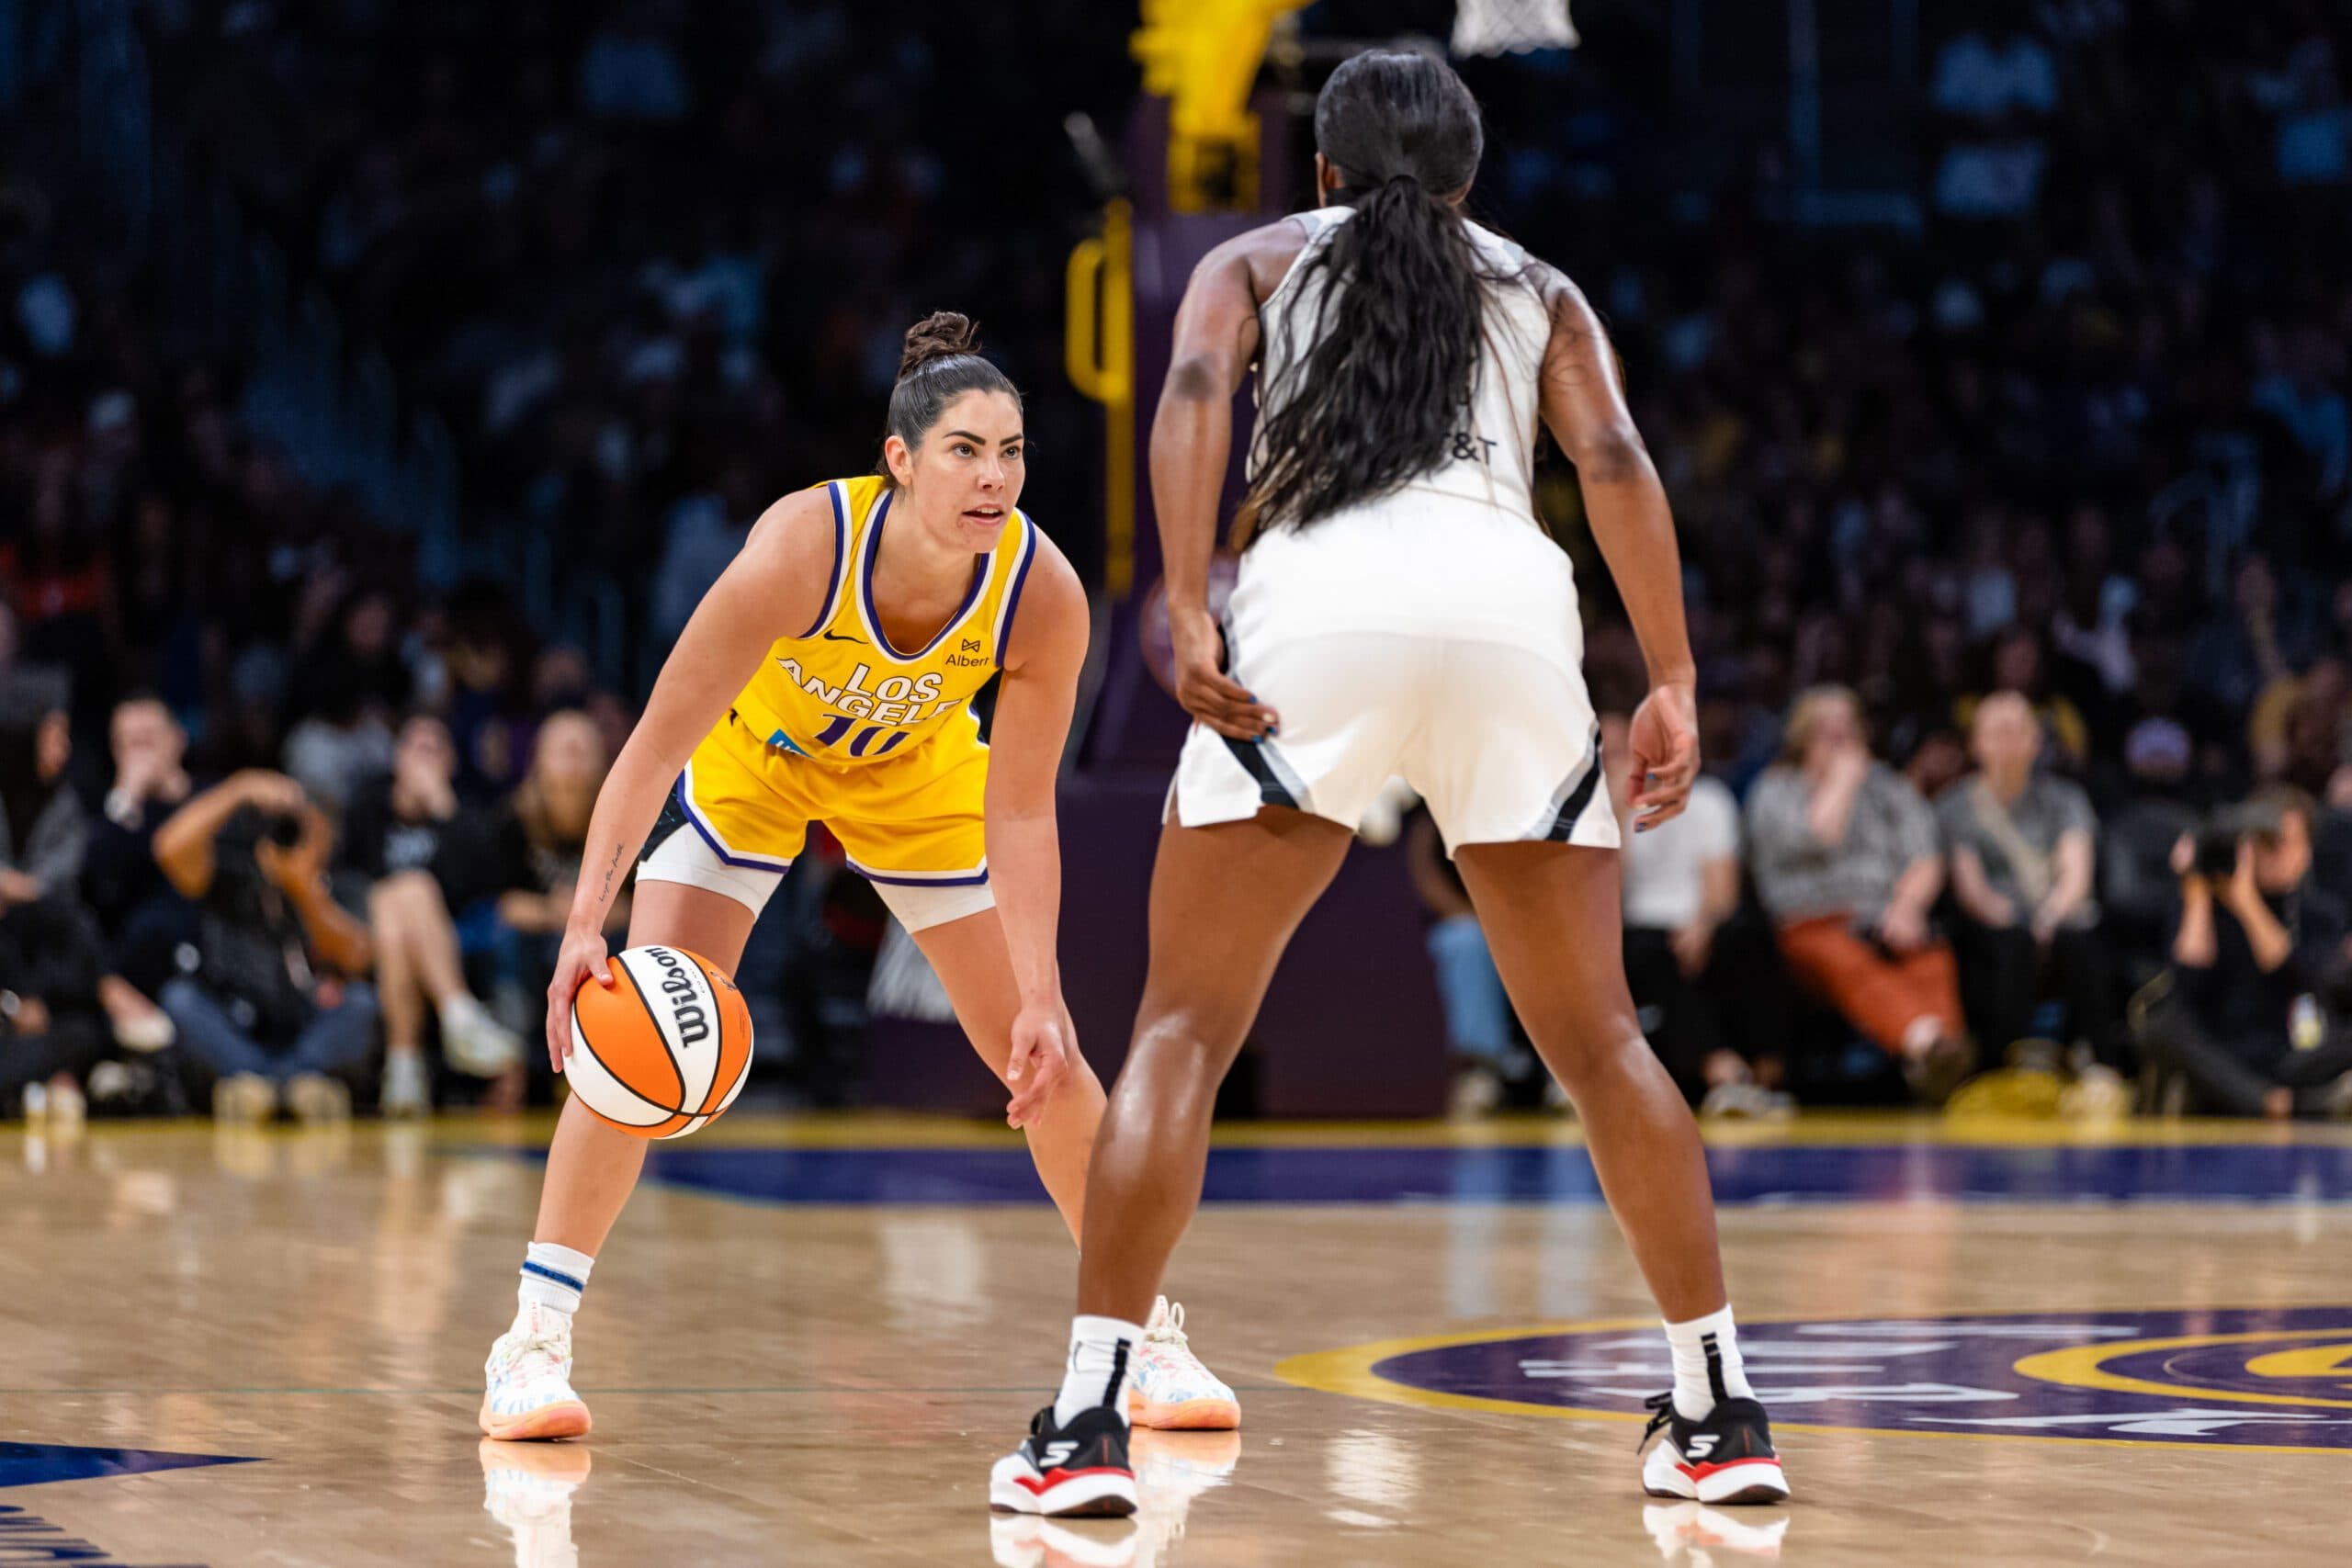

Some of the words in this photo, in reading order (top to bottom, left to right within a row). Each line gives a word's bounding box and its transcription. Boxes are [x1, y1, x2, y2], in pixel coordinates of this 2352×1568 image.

[1443, 432, 1498, 465] &T
[945, 654, 989, 667] Albert
[776, 657, 963, 727] ANGEL
[843, 662, 943, 702] LOS
[814, 714, 911, 757] 10
[644, 947, 709, 1049] Wilson
